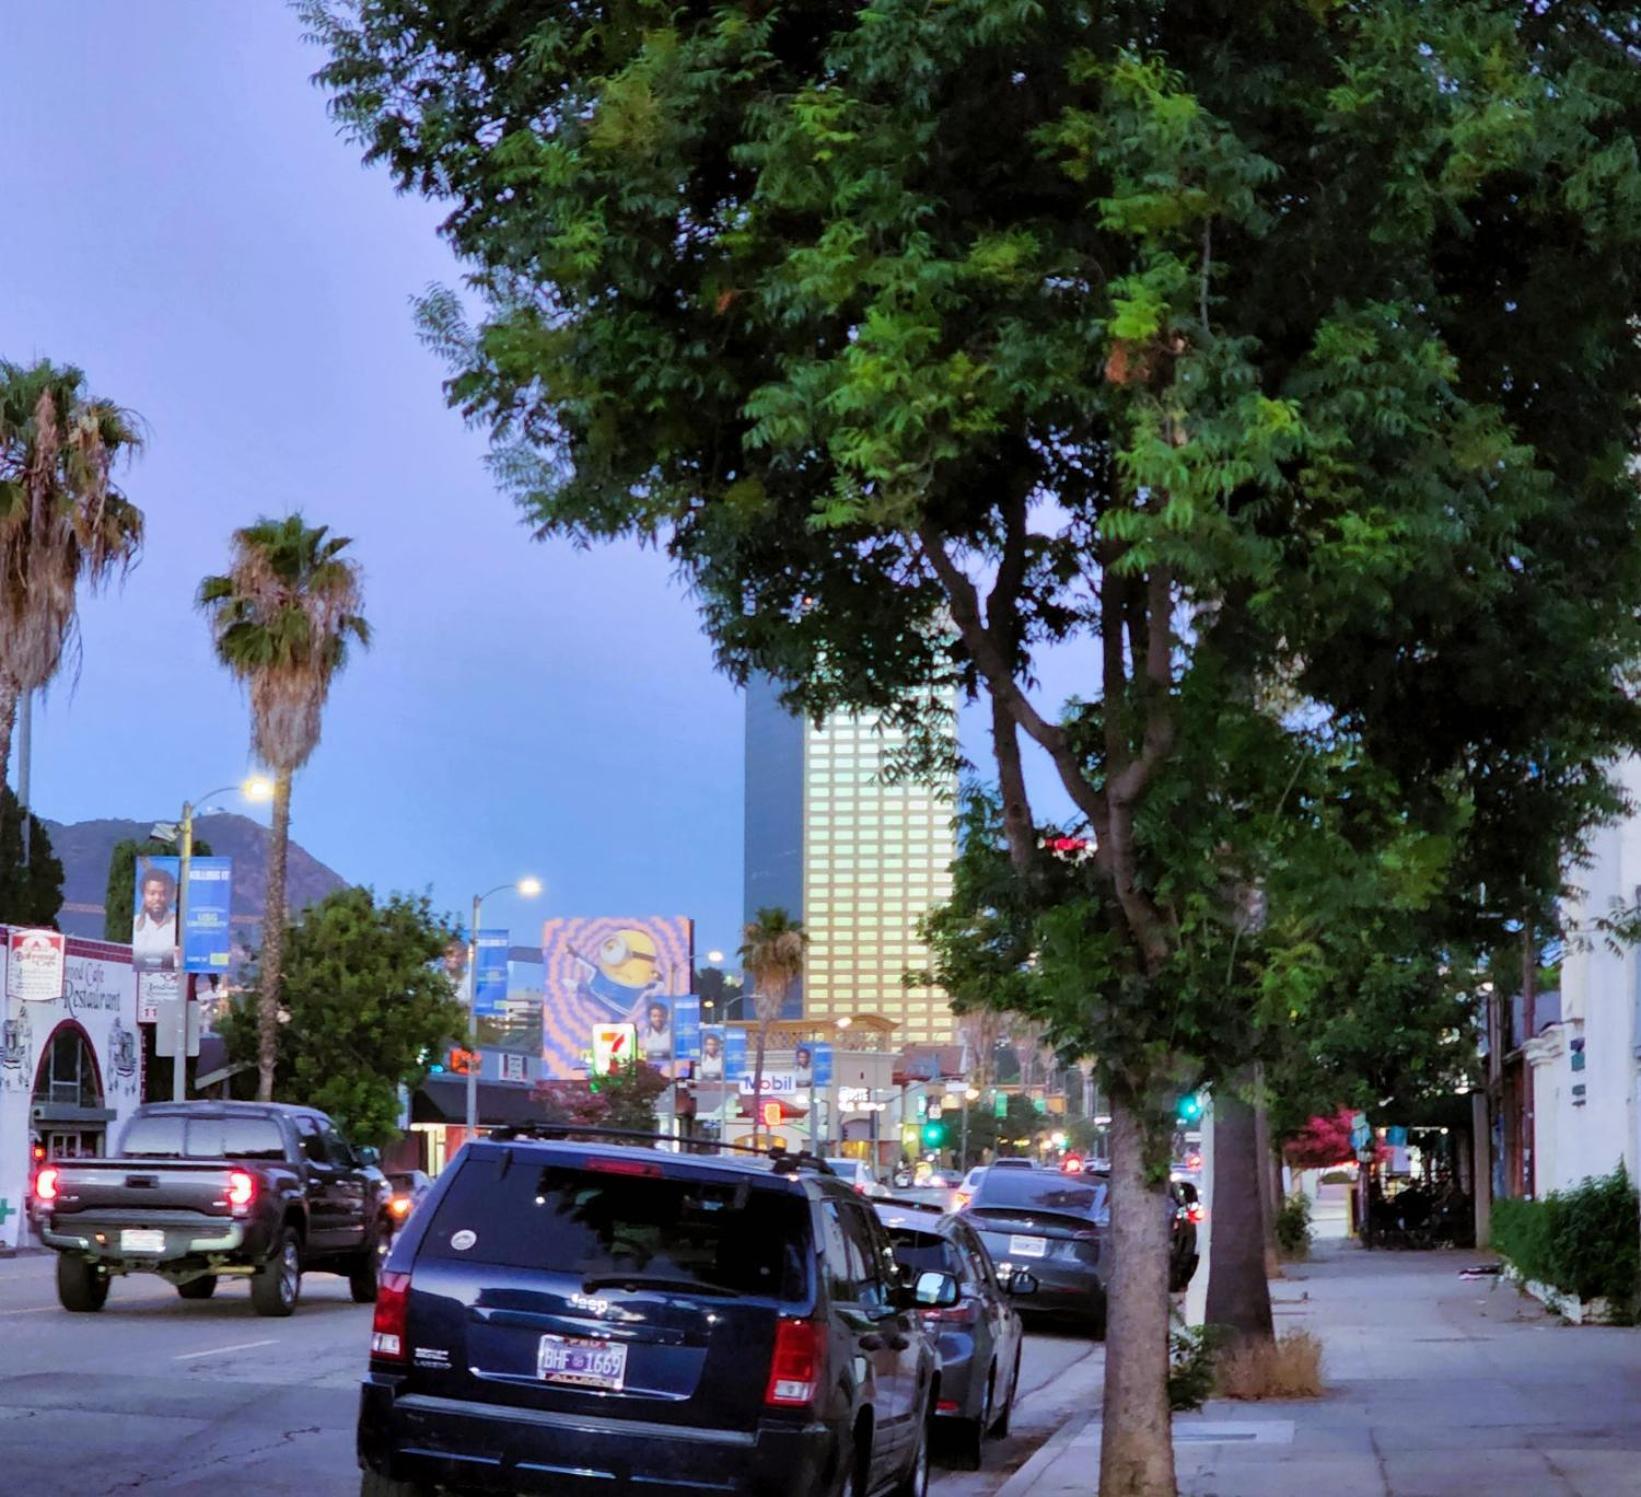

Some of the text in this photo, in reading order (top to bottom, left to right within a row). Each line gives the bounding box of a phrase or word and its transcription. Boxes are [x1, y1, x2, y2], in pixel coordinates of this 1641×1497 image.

[64, 980, 120, 1018] Restaurant
[744, 1075, 792, 1091] Mobil
[543, 1347, 621, 1376] BHF 1669
